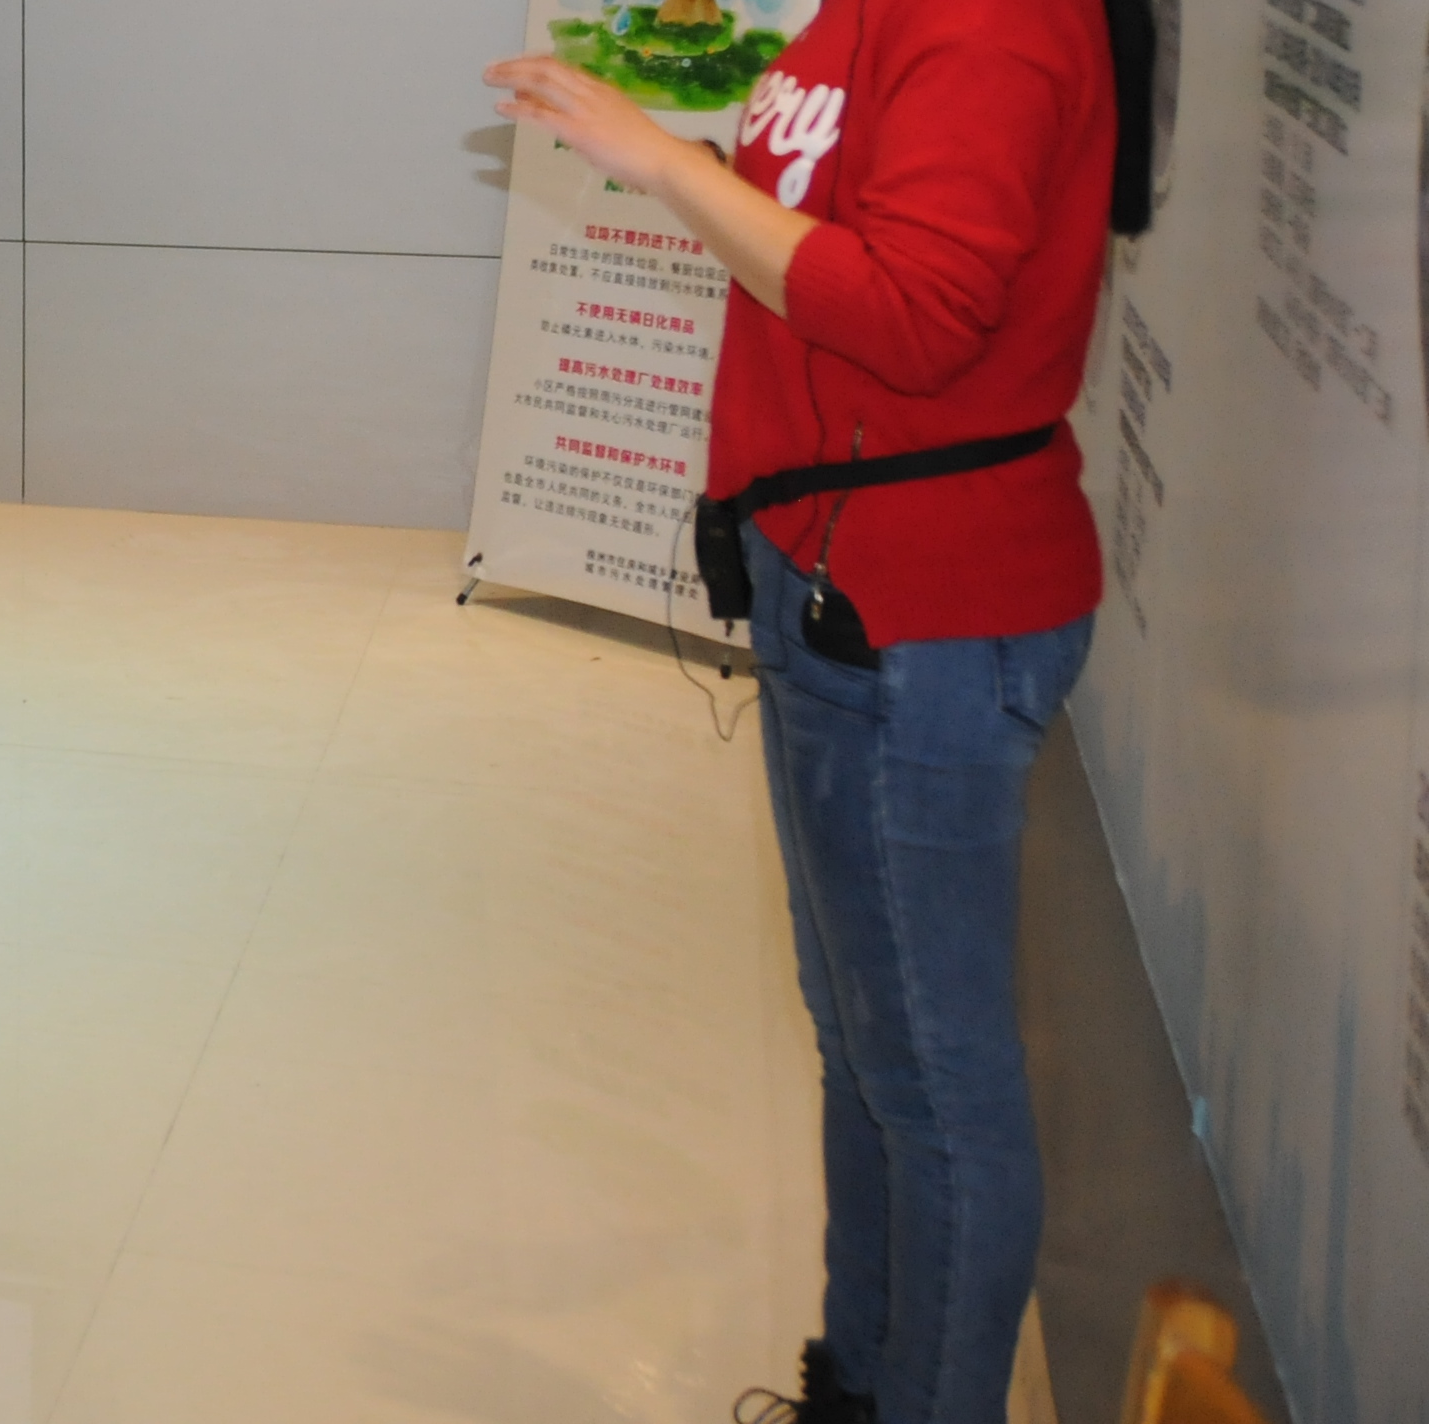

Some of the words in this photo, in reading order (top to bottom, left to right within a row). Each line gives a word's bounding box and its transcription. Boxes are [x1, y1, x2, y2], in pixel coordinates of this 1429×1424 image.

[584, 225, 704, 256] 垃圾不要扔进下水道
[558, 357, 703, 397] 提高污水处理厂处理效率
[554, 435, 687, 477] 共同监督和保护水环境
